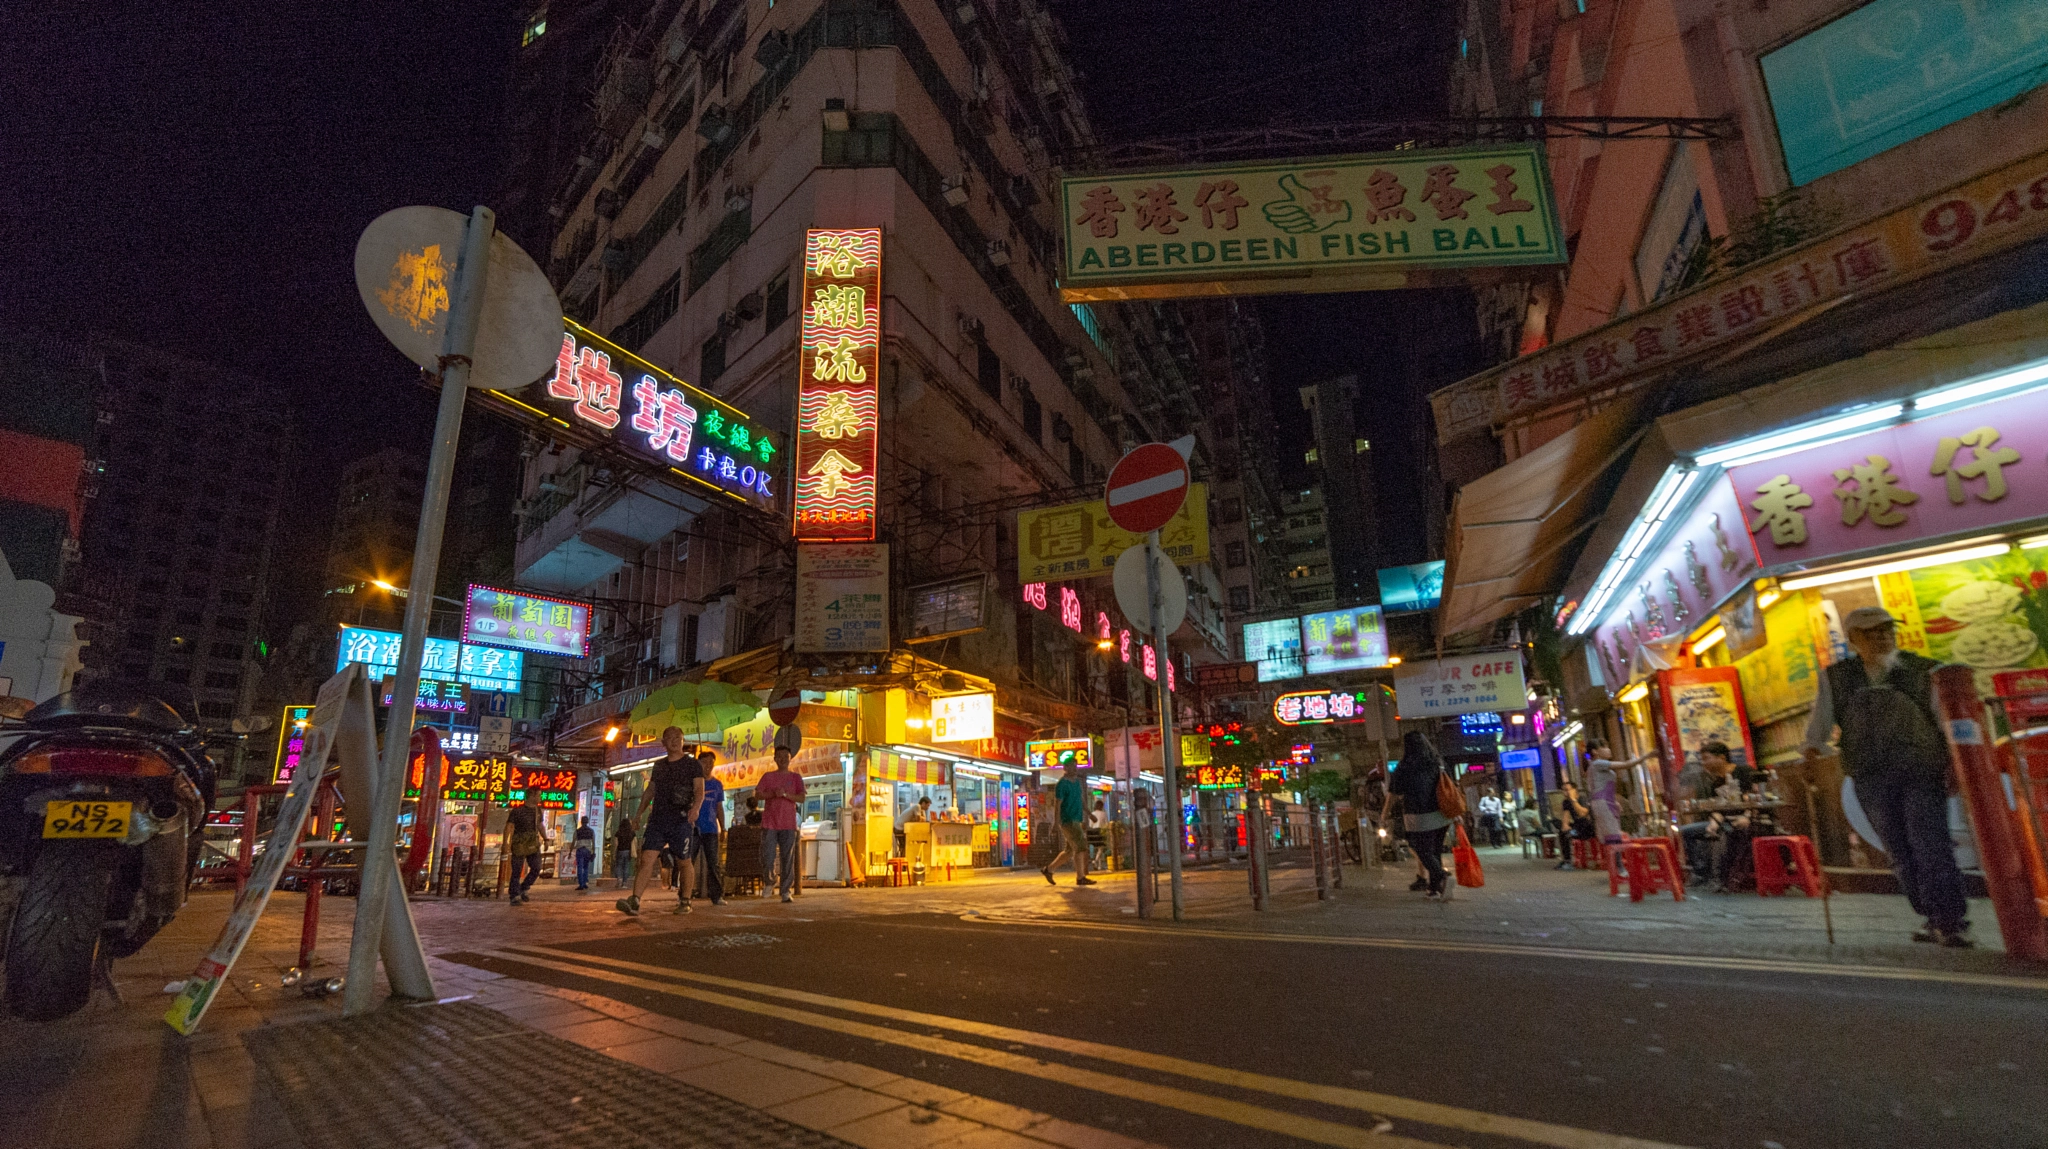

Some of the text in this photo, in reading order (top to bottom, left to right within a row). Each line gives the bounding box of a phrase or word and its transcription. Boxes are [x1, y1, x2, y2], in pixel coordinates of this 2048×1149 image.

[1307, 169, 1345, 215] 一品
[1364, 163, 1535, 225] 魚蛋王
[1075, 179, 1249, 238] 香港仔
[1078, 224, 1542, 270] ABERDEEN FISH BALL
[807, 234, 867, 499] 浴潮流桑拿
[703, 409, 777, 463] 夜總會
[1750, 425, 2021, 546] 香港仔
[1033, 557, 1091, 578] 全新套房
[491, 592, 573, 630] 葡萄園
[824, 599, 842, 613] 4
[477, 620, 496, 631] 1/F
[824, 627, 843, 641] 3
[1309, 611, 1380, 642] 葡萄園
[1471, 660, 1514, 678] CAFE
[1278, 692, 1355, 721] 老地坊
[454, 777, 504, 792] 大酒店
[52, 818, 124, 834] 9472
[71, 804, 109, 819] NS
